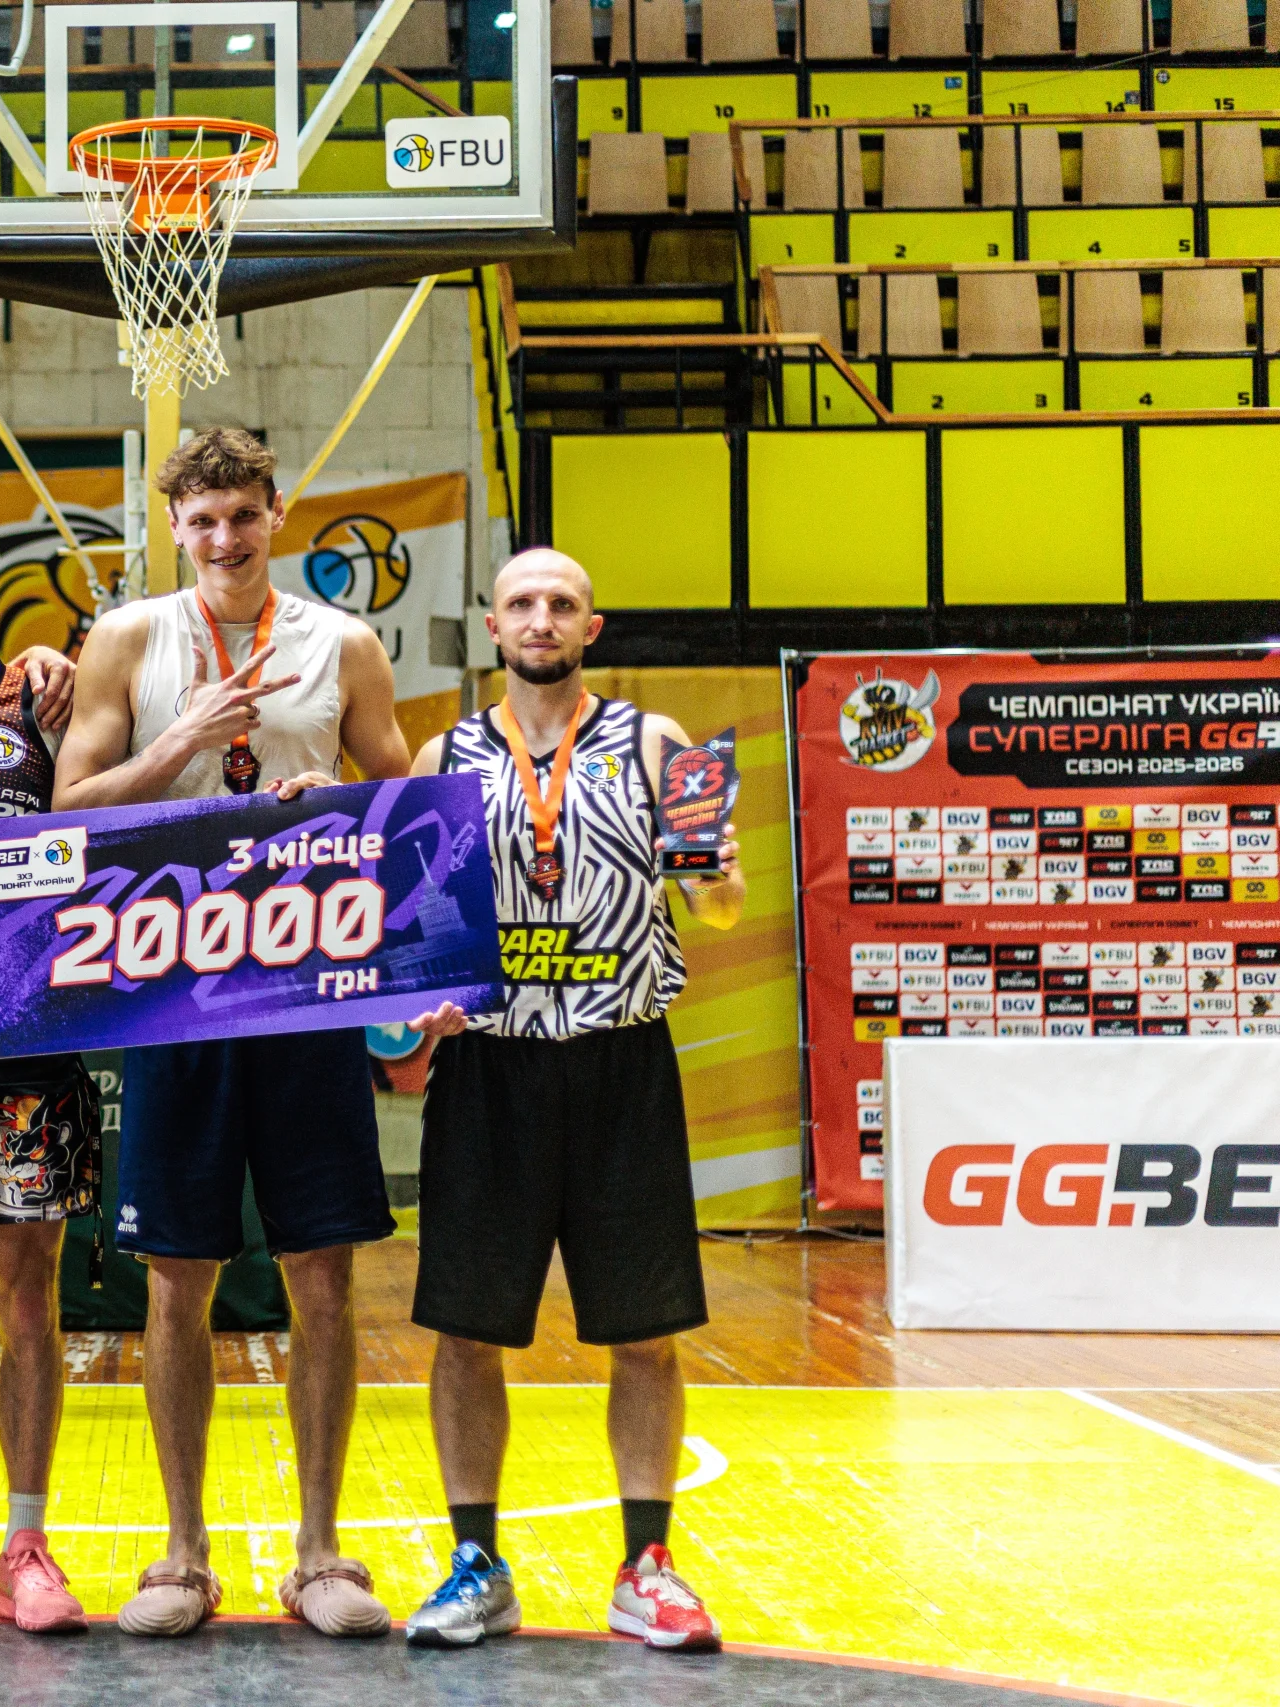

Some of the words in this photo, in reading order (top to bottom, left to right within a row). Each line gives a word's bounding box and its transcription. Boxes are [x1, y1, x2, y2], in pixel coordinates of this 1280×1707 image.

[714, 105, 734, 118] 10
[814, 104, 830, 117] 11
[913, 103, 932, 117] 12
[1009, 103, 1029, 116] 13
[1215, 98, 1235, 112] 15
[439, 138, 505, 167] FBU
[785, 243, 794, 258] 1
[895, 244, 907, 258] 2
[987, 243, 999, 257] 3
[1088, 241, 1102, 254] 4
[1178, 238, 1191, 252] 5
[823, 395, 832, 410] 1
[931, 395, 945, 409] 2
[1035, 394, 1047, 408] 3
[1139, 392, 1154, 406] 4
[1237, 392, 1250, 406] 5
[989, 694, 1174, 718] ЧЕМПІОНАТ
[969, 723, 1191, 752] СУПЕРЛІГА
[1065, 759, 1133, 775] СЕЗОН
[1137, 757, 1245, 774] 2025-2026
[589, 782, 617, 794] FBU
[947, 813, 980, 825] BGV
[1187, 810, 1220, 822] BGV
[996, 837, 1030, 849] BGV
[1236, 834, 1271, 846] BGV
[226, 838, 255, 872] 3
[266, 829, 385, 872] місце
[1044, 861, 1078, 873] BGV
[33, 876, 75, 888] УКРАЇНИ
[1093, 885, 1127, 897] BGV
[49, 877, 386, 988] 20000
[905, 948, 937, 961] BGV
[1192, 948, 1226, 960] BGV
[501, 955, 619, 980] MATCH
[316, 966, 378, 1000] грн
[953, 973, 986, 986] BGV
[1242, 973, 1276, 984] BGV
[1002, 999, 1035, 1011] BGV
[1051, 1024, 1084, 1036] BGV
